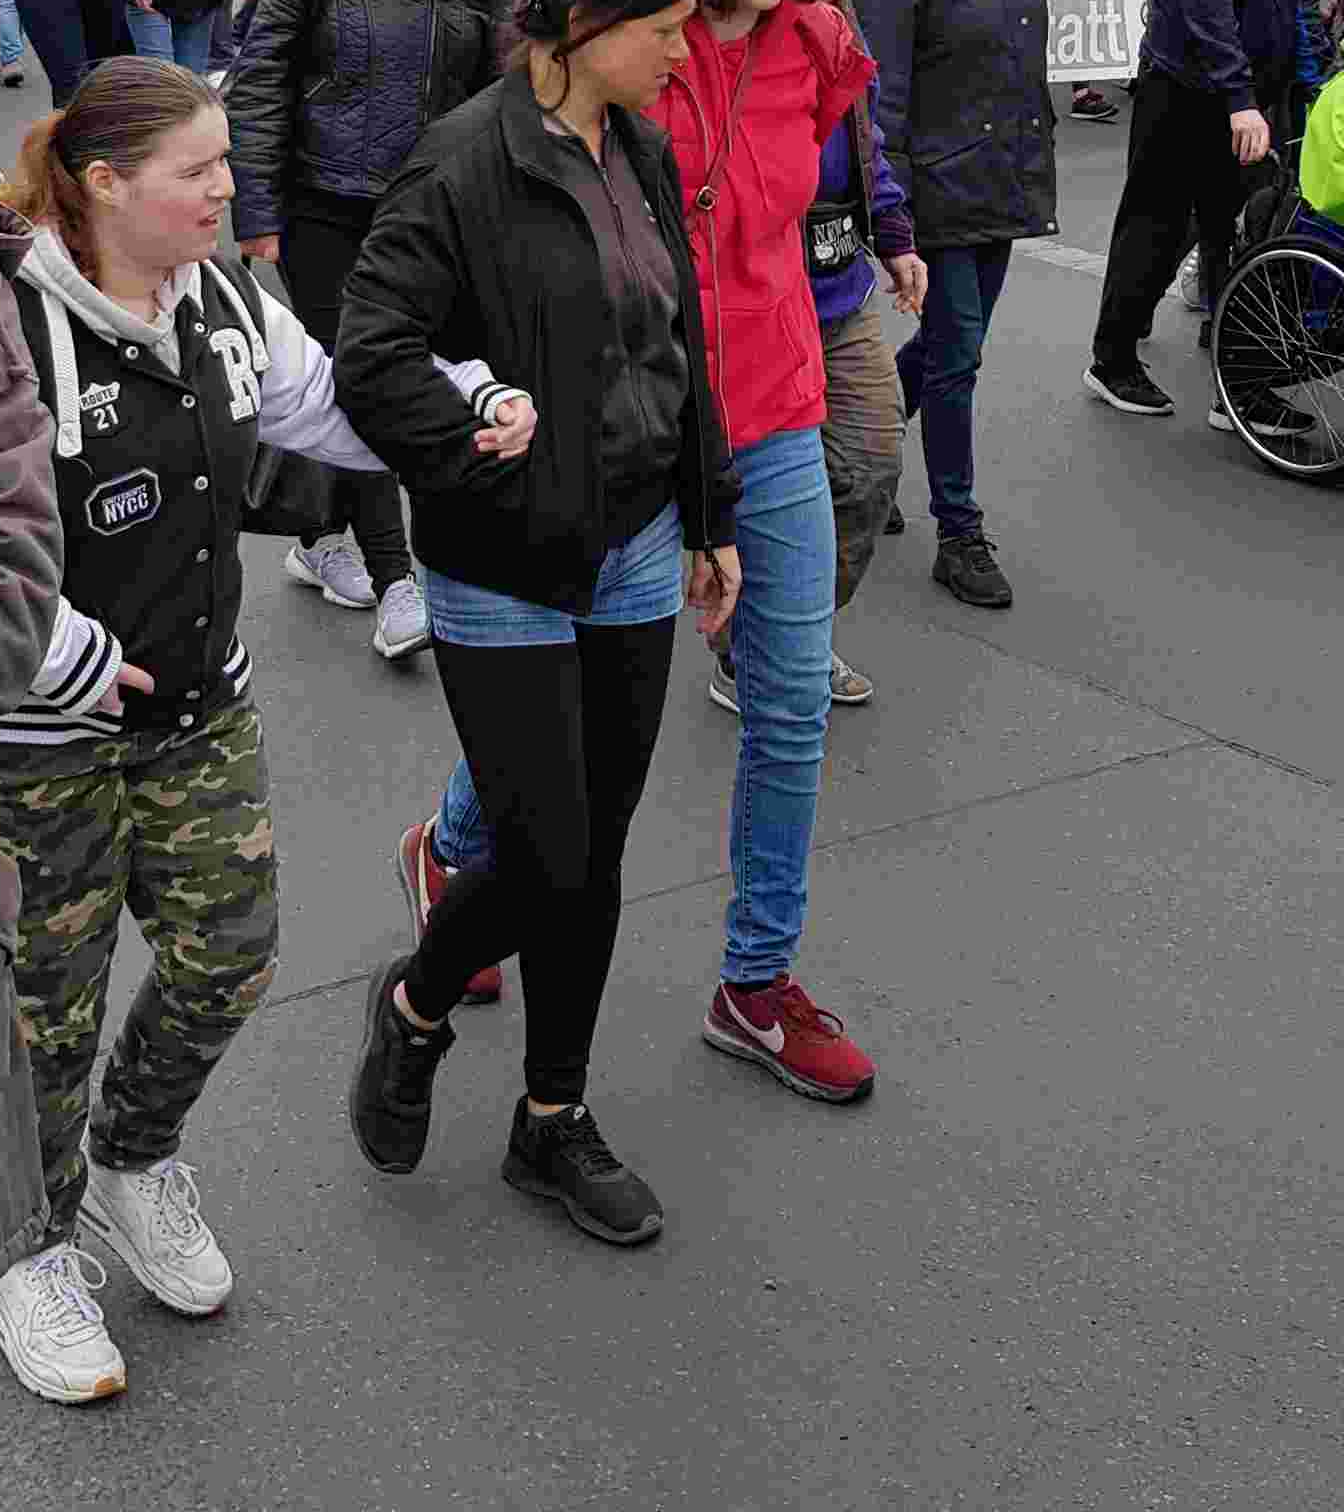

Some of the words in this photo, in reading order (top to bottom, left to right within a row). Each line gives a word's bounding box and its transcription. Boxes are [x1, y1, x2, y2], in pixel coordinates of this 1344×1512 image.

[210, 327, 258, 422] R
[80, 388, 116, 408] ROUTE
[93, 403, 119, 431] 21
[103, 492, 149, 525] NYCC
